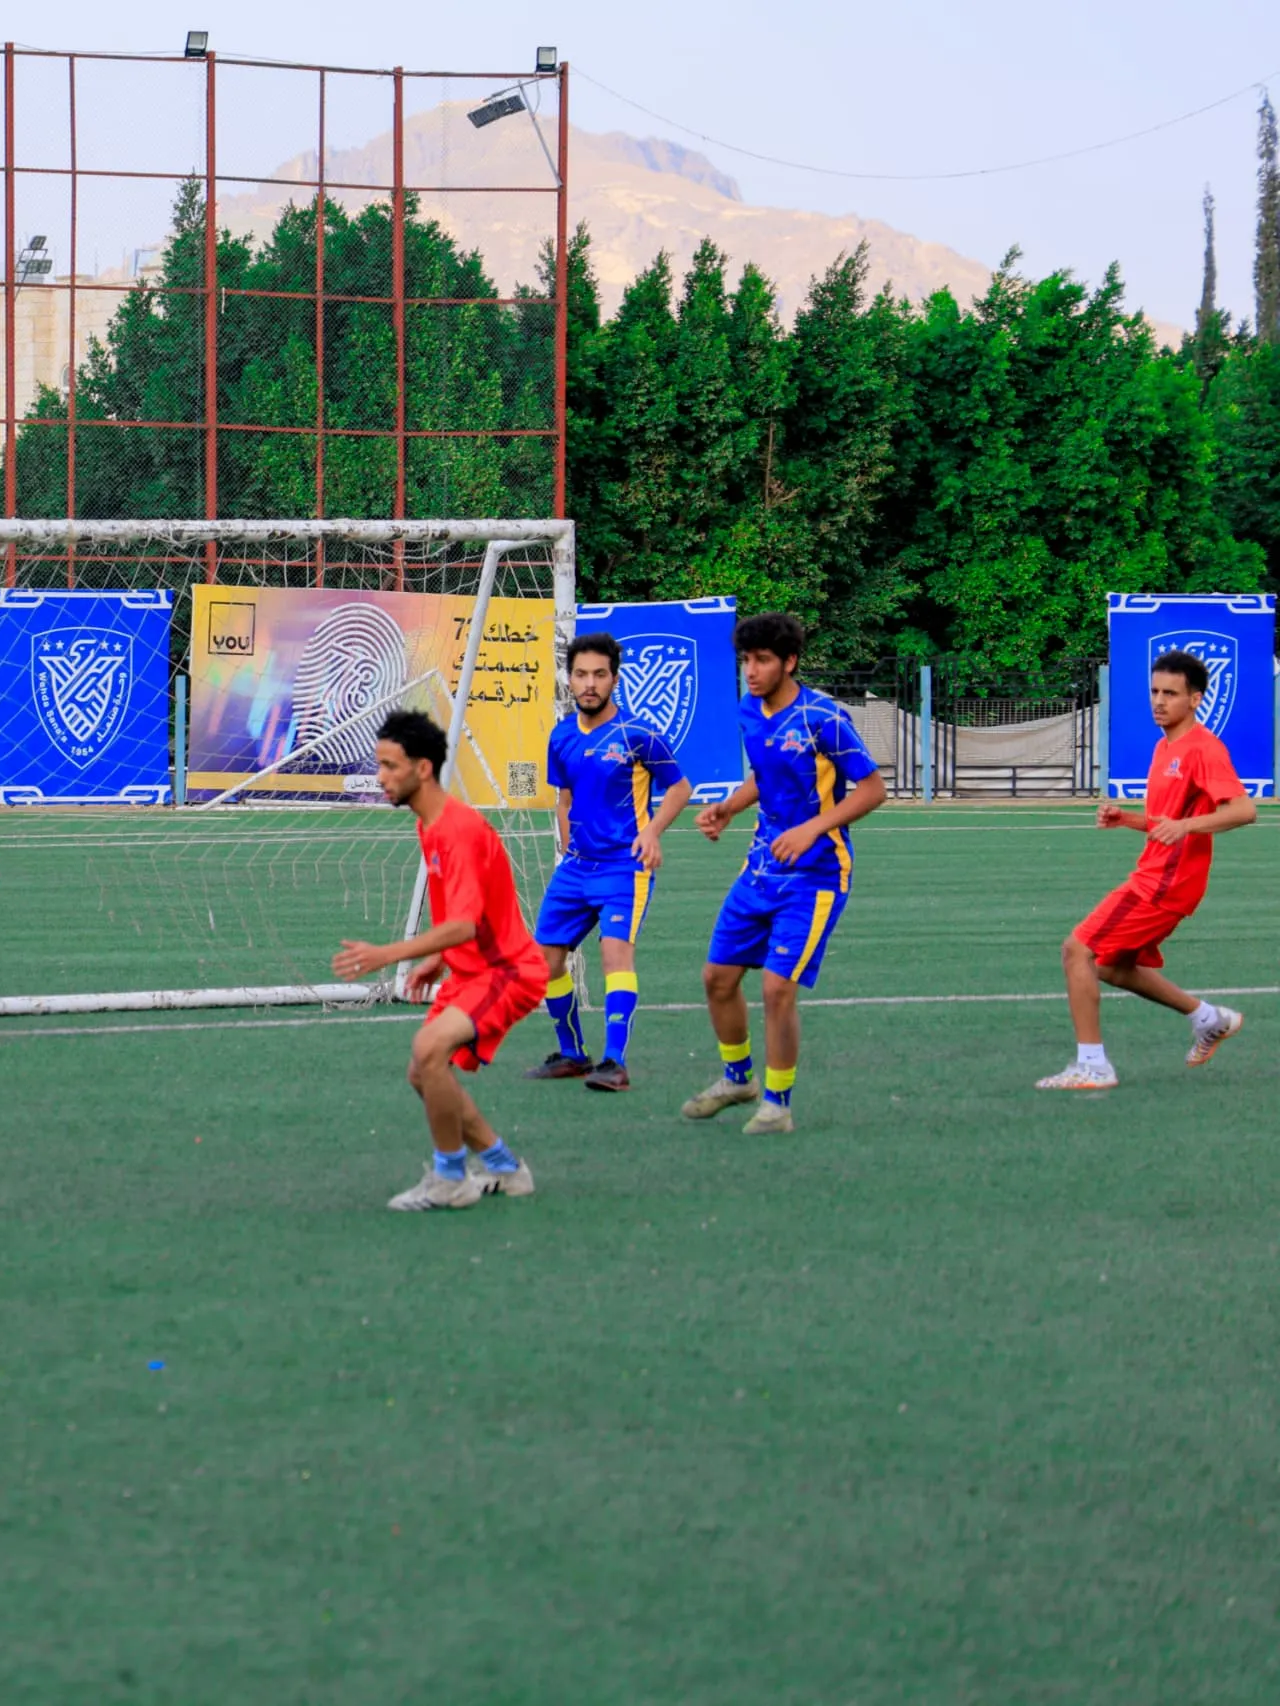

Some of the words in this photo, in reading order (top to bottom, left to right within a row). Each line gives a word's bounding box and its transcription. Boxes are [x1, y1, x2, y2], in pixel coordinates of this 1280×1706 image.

[213, 635, 250, 650] YOU
[483, 623, 539, 643] خطك
[39, 671, 50, 708] Wahda
